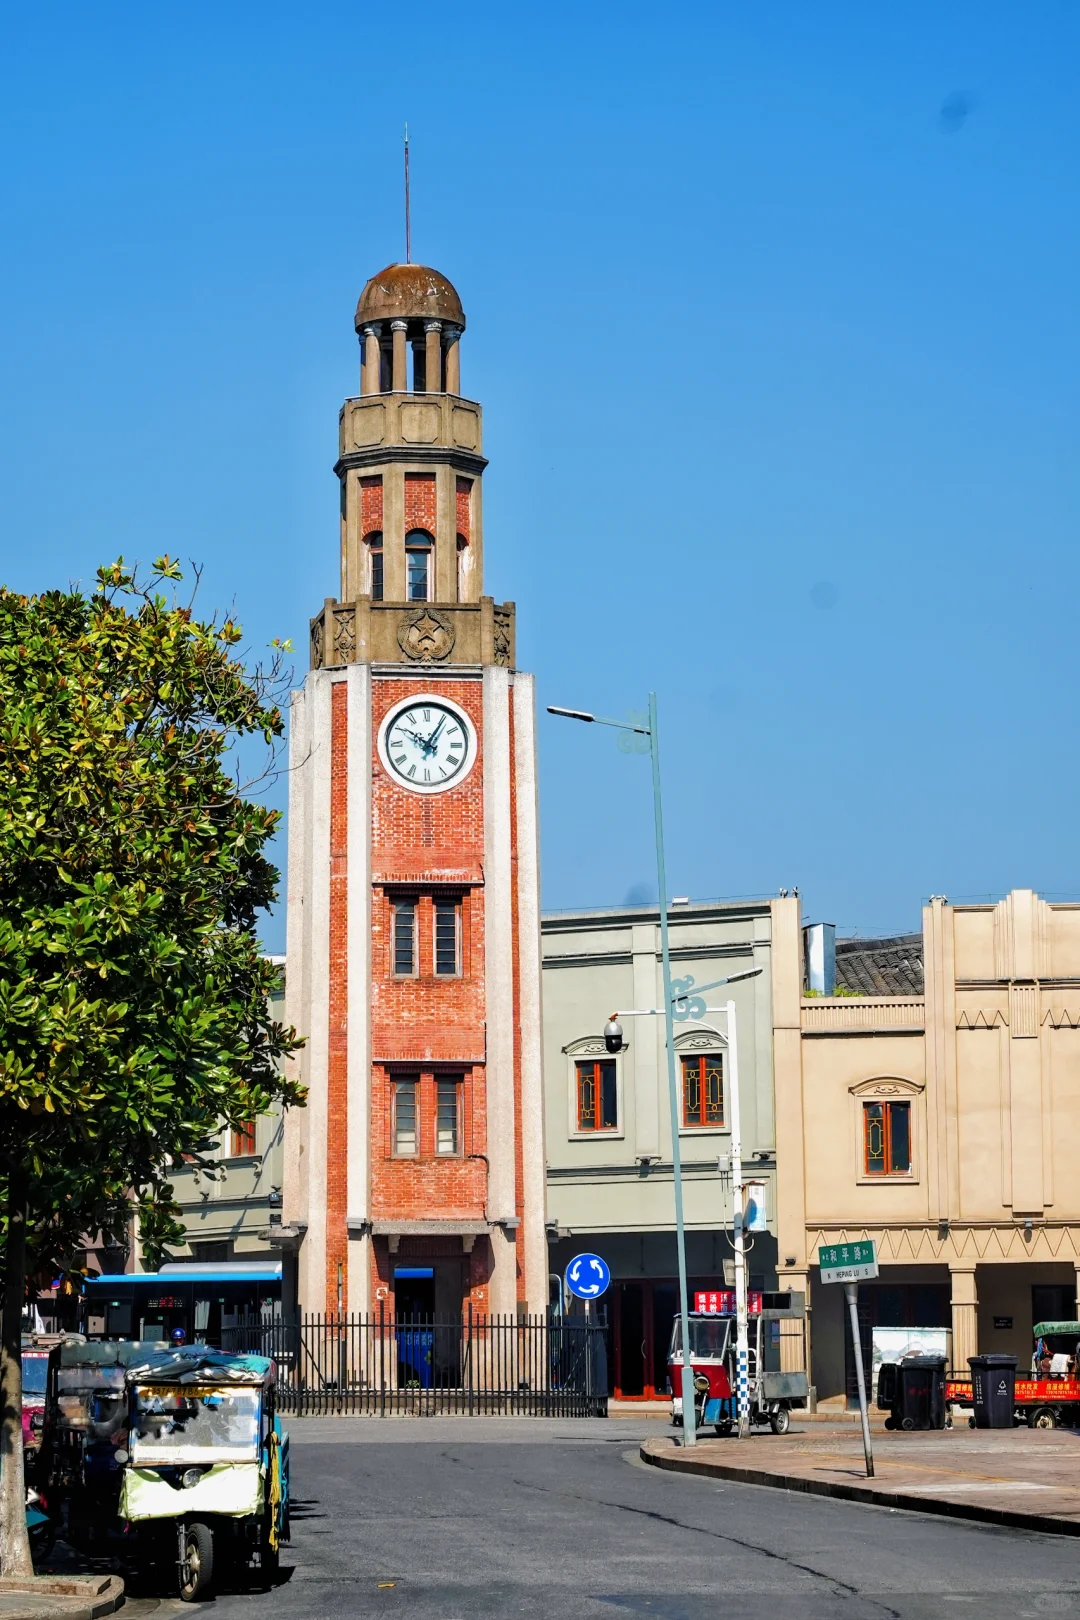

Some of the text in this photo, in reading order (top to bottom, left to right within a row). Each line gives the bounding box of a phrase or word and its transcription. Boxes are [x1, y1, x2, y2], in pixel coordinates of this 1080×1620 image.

[829, 1246, 862, 1264] 和平路
[836, 1270, 852, 1279] HEPING
[854, 1269, 860, 1277] LU
